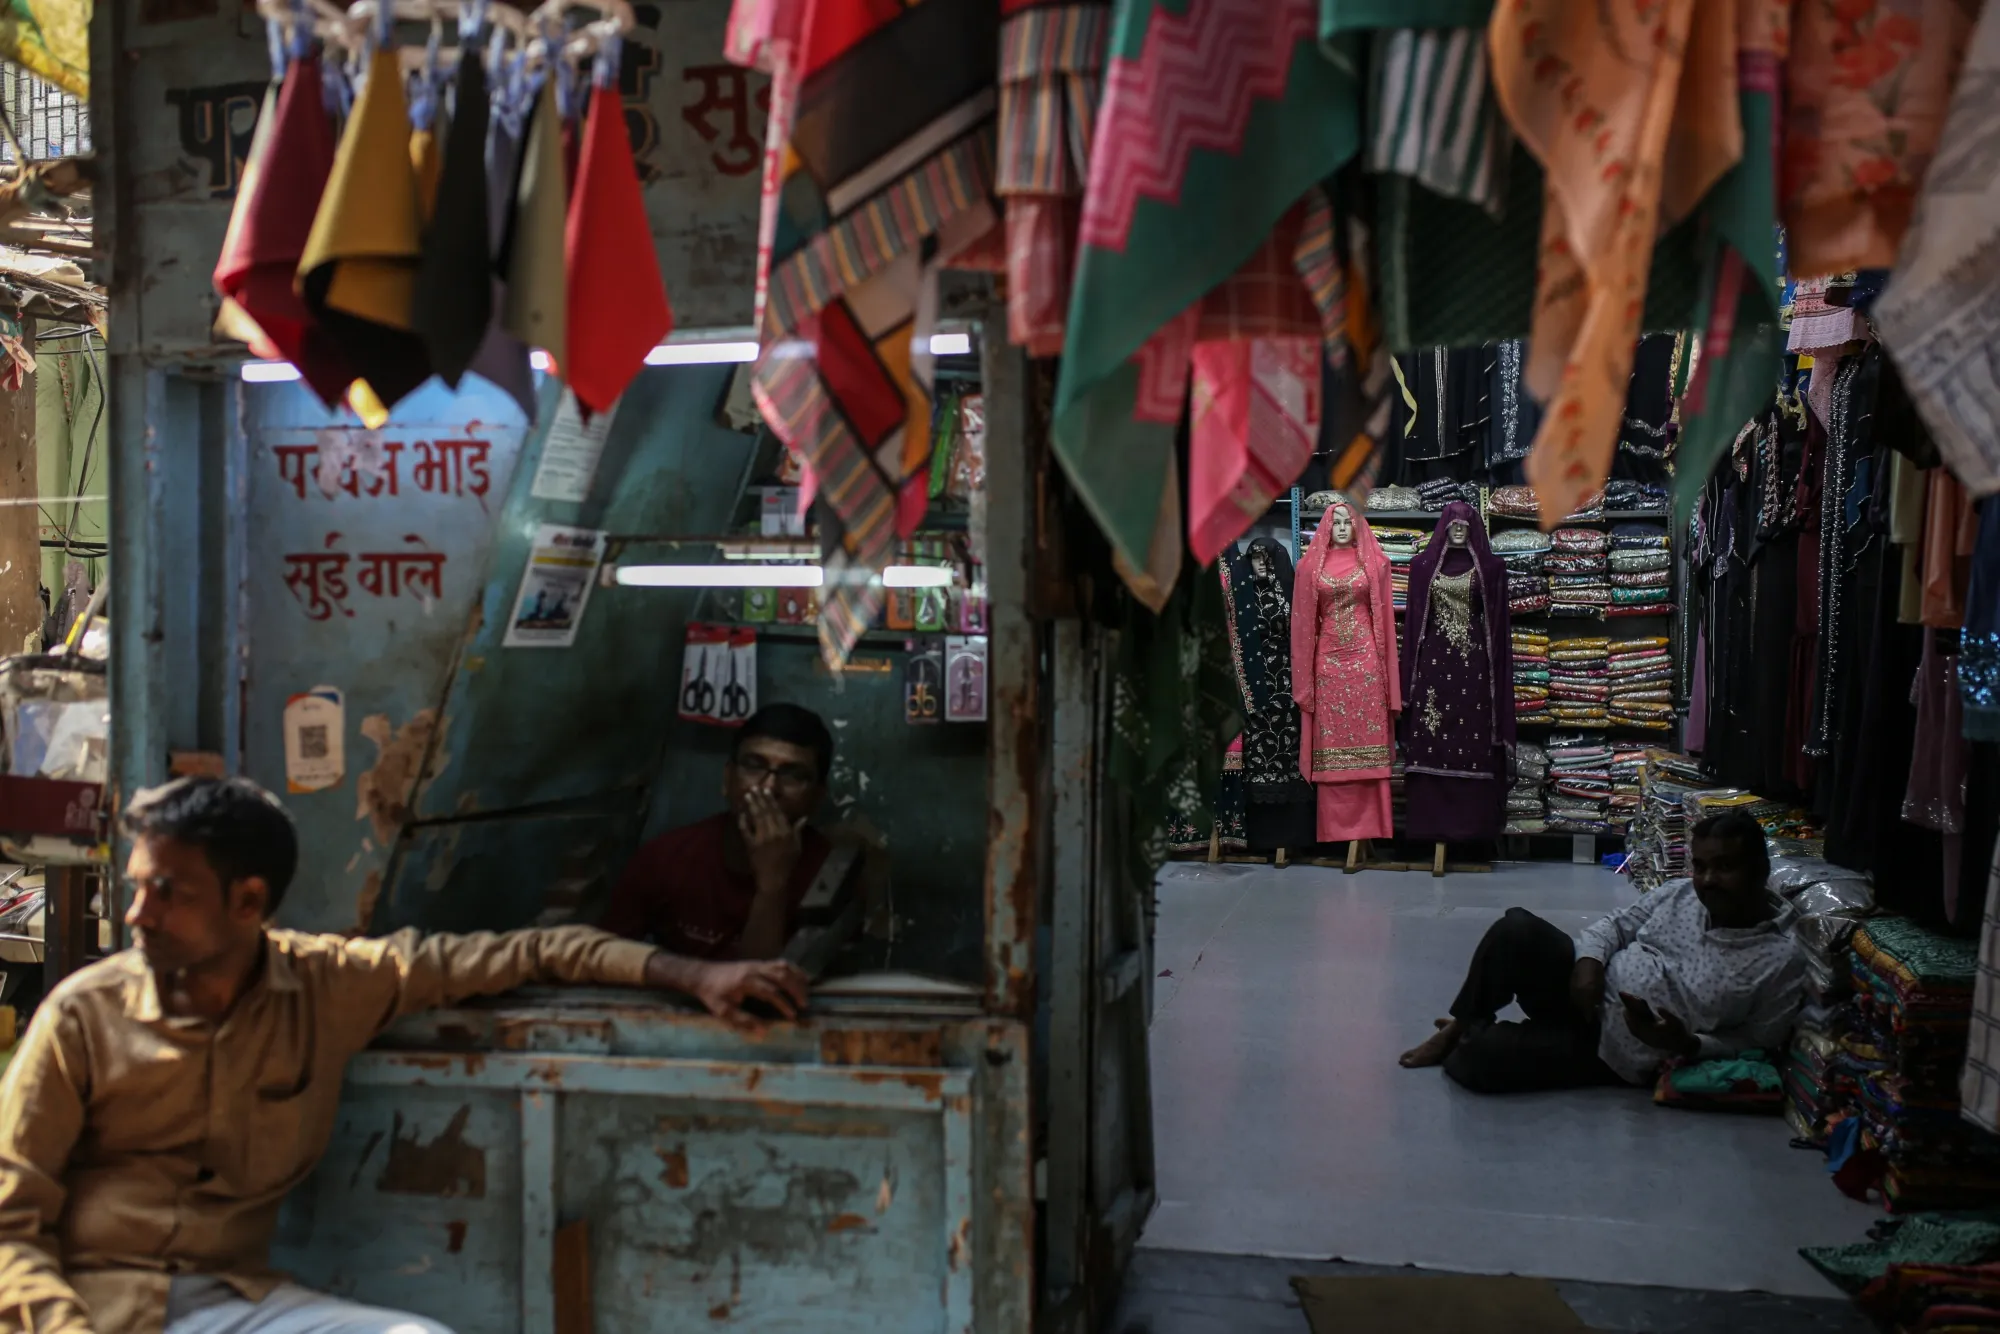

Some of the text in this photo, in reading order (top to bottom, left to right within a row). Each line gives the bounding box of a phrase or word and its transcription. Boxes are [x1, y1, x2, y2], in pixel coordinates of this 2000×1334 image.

[413, 419, 492, 513] भाई
[283, 531, 447, 620] सुई वाले
